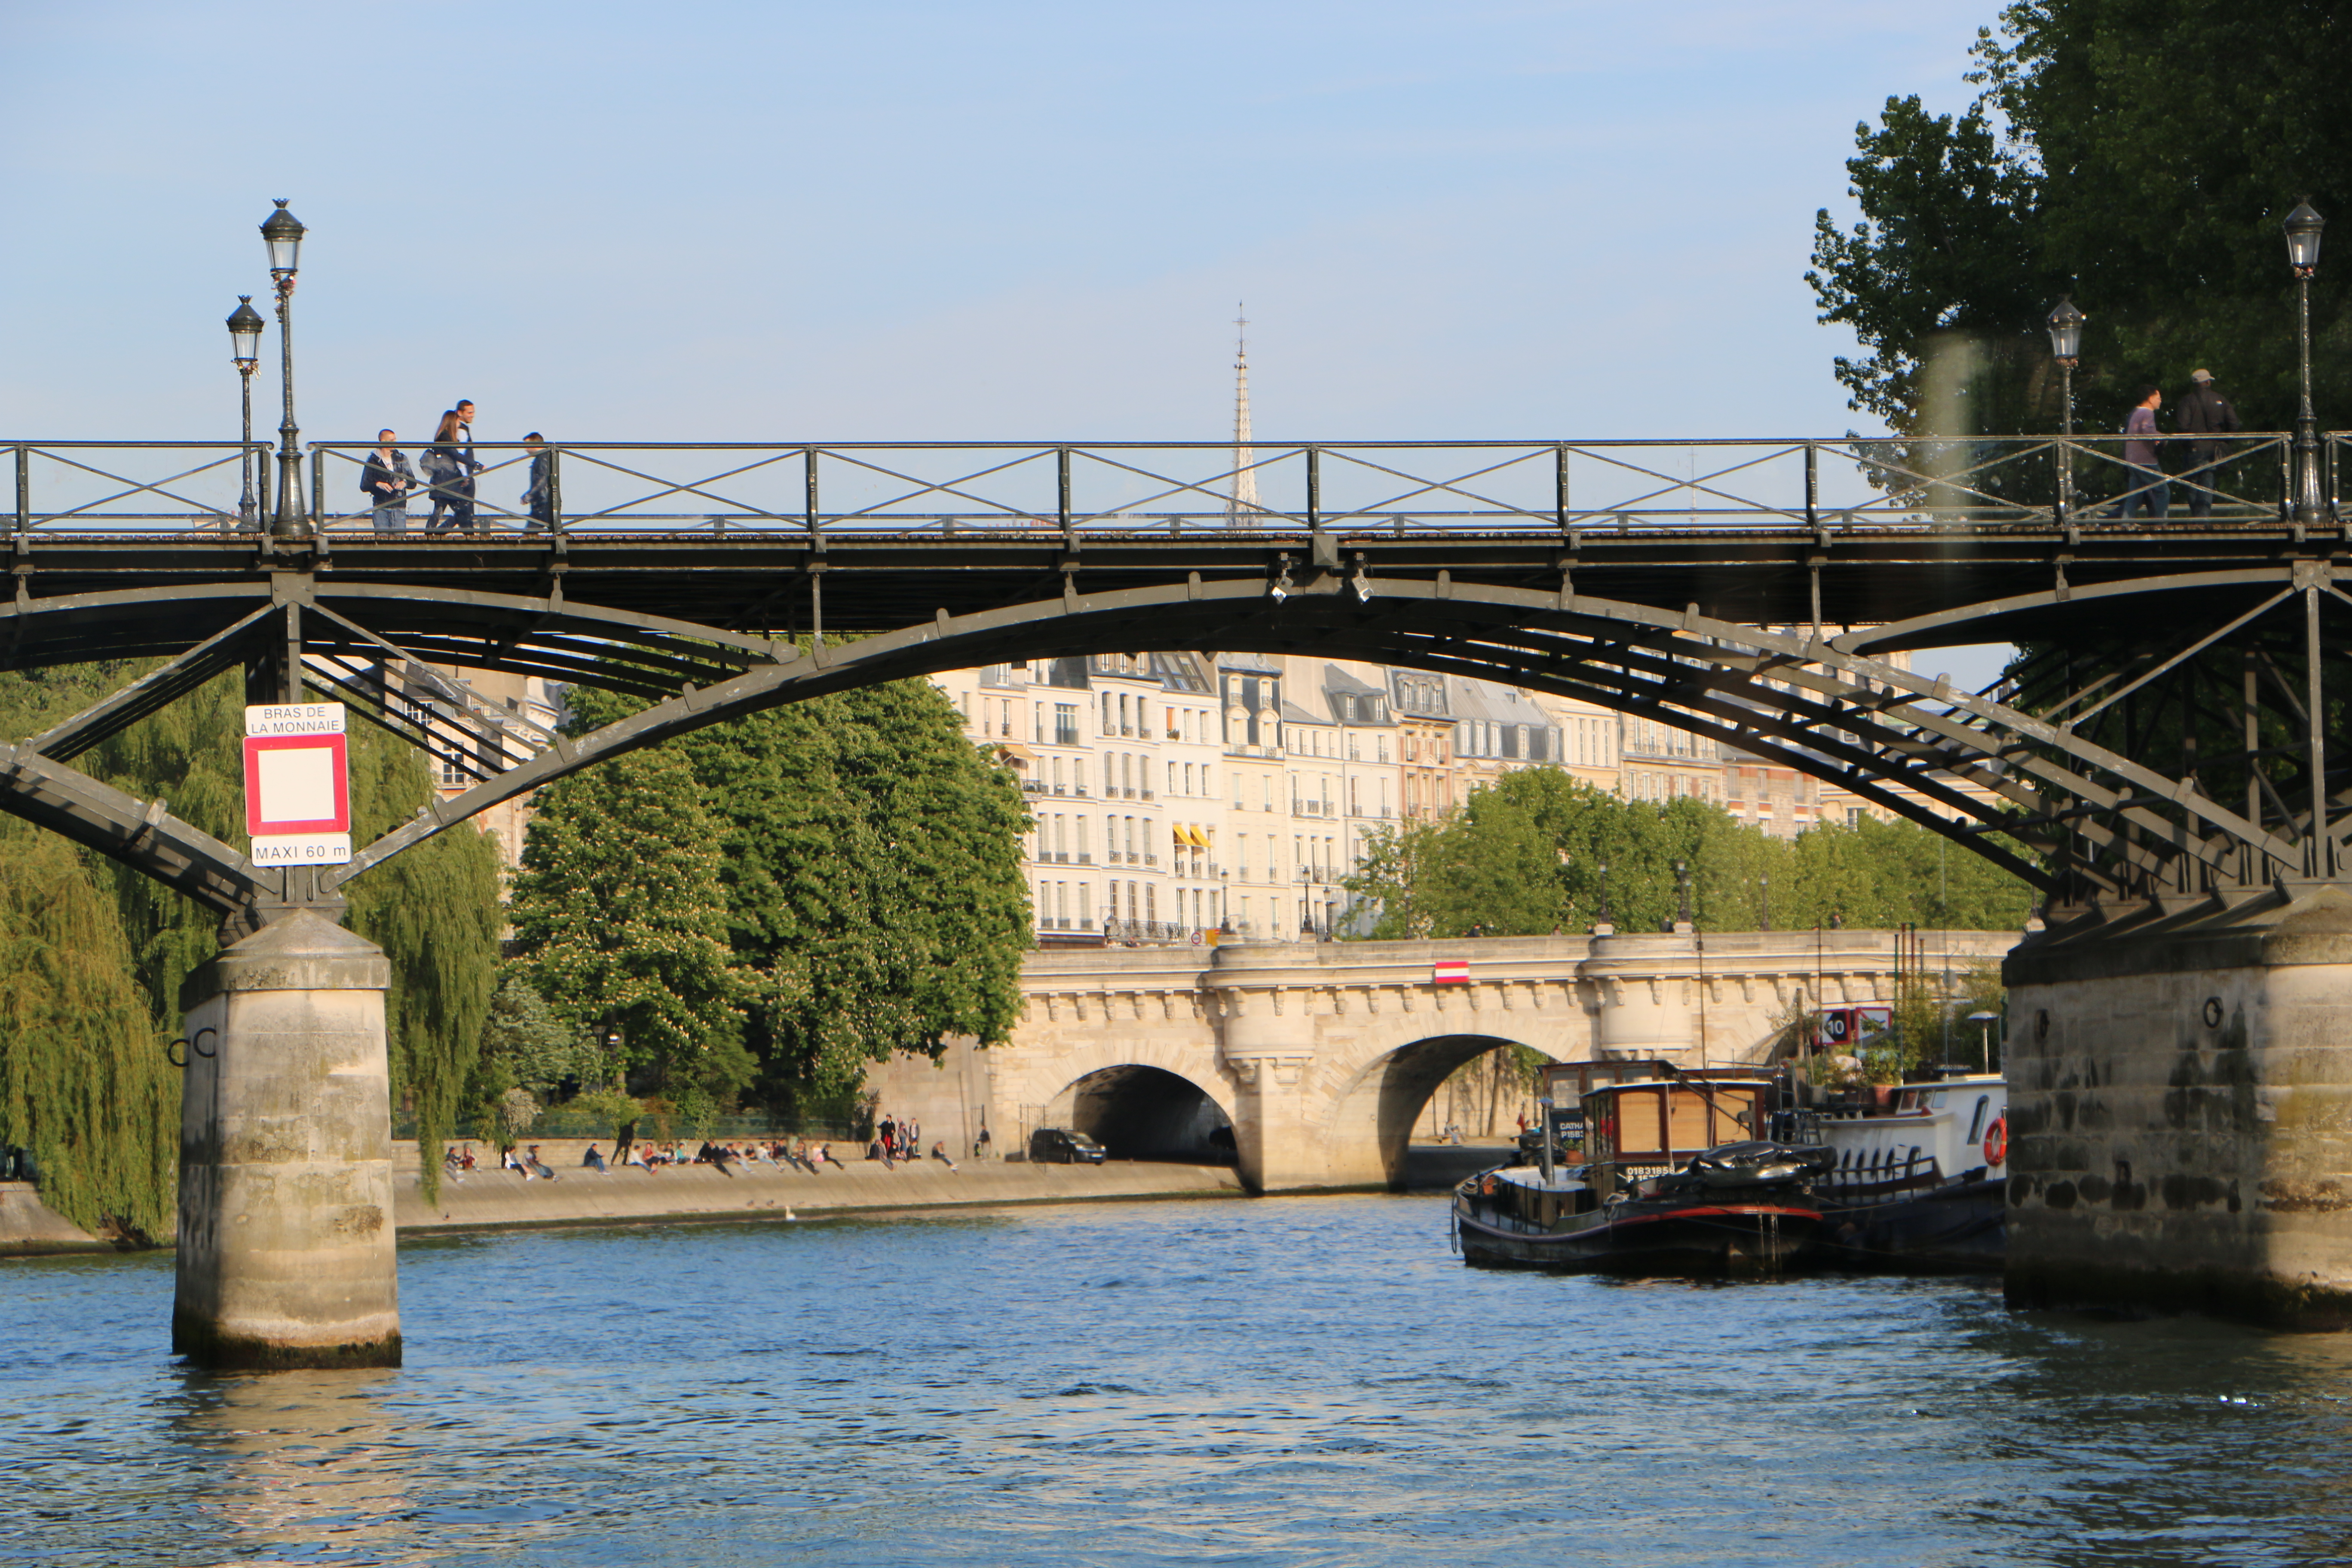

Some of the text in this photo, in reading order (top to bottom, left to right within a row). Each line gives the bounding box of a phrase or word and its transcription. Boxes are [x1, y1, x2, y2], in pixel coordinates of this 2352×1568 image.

[264, 706, 325, 719] BRAS DE
[251, 720, 339, 733] LA MONNAIE
[256, 845, 346, 859] MAXI 60 m
[1828, 1020, 1844, 1034] 10
[1626, 1166, 1675, 1175] 01831858
